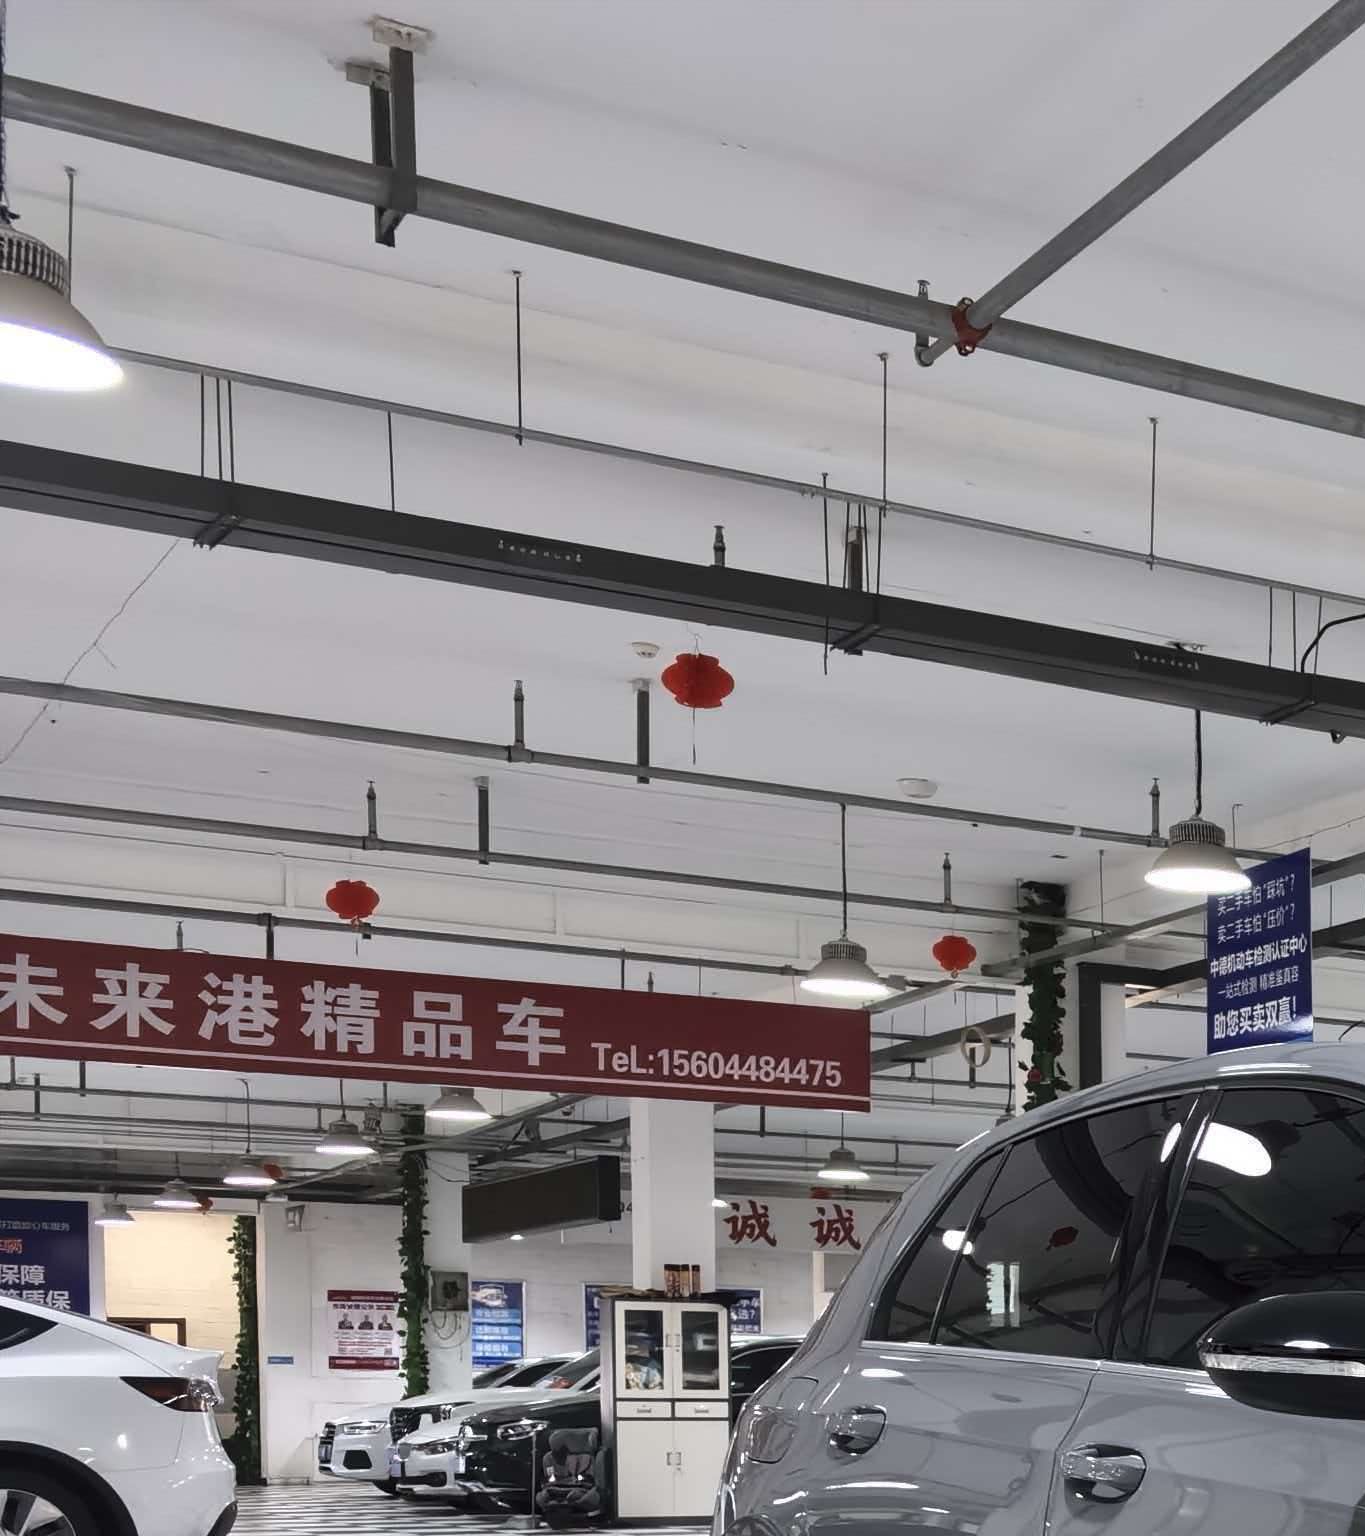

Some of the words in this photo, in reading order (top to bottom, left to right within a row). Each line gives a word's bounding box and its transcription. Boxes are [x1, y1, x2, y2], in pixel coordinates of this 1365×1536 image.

[1210, 932, 1307, 978] 中德机动车检测认证中心
[0, 953, 567, 1066] 未来港精品车
